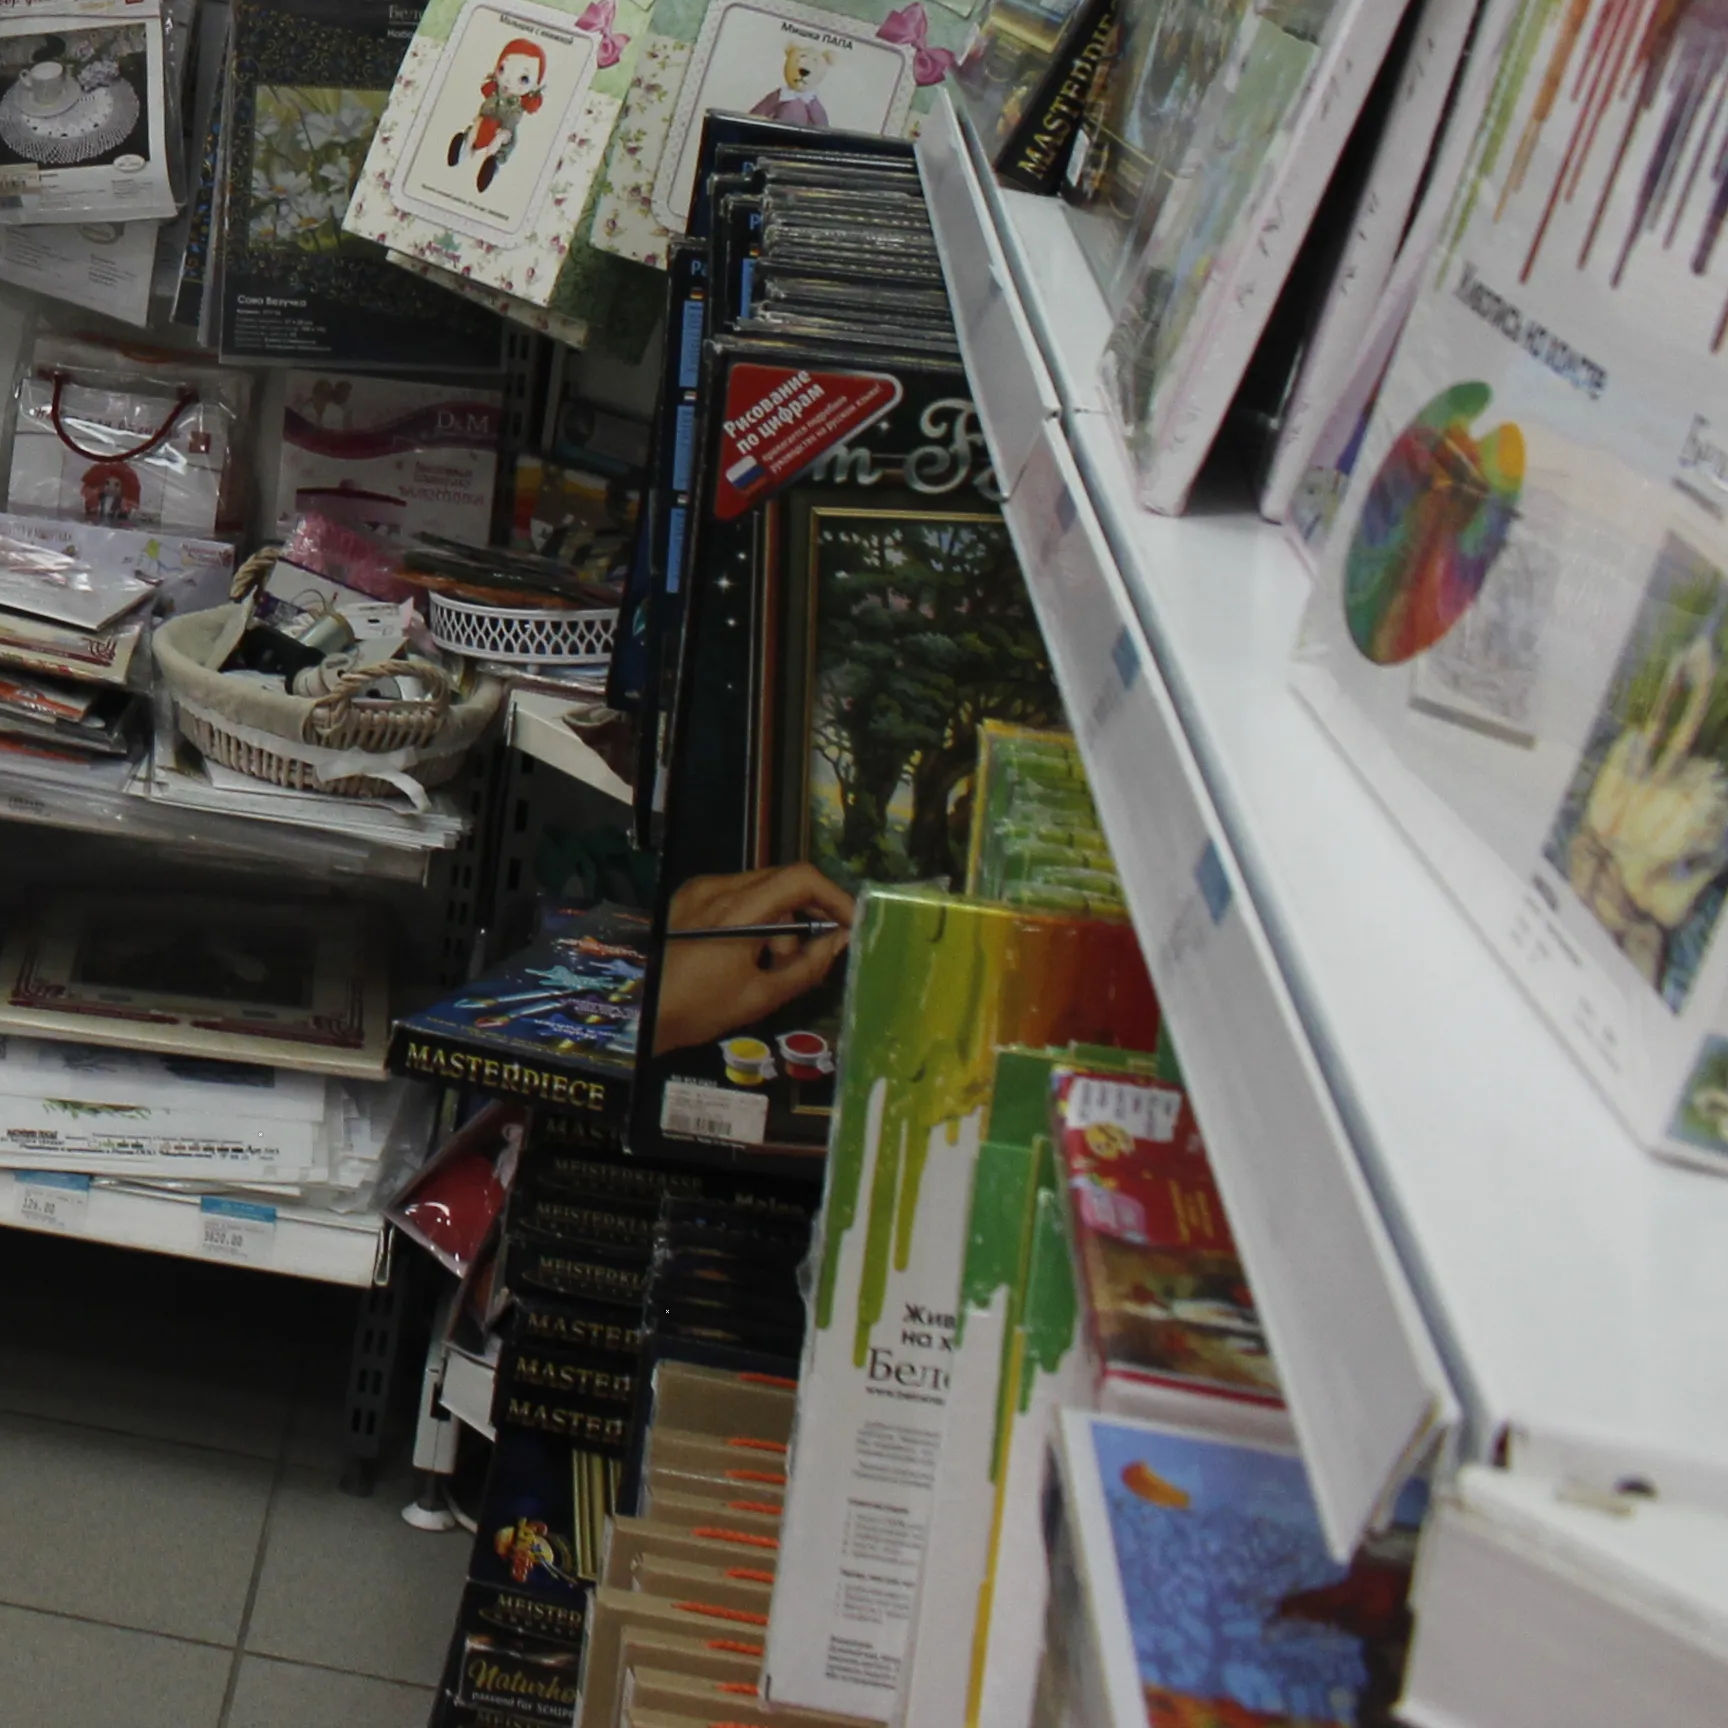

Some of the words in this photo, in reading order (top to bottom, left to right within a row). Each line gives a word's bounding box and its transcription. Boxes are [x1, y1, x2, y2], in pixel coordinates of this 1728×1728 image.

[780, 20, 820, 44] Мишка
[722, 369, 813, 439] Рисование
[735, 433, 761, 454] по
[758, 382, 826, 439] цифрам
[405, 1042, 606, 1112] MASTERPIECE
